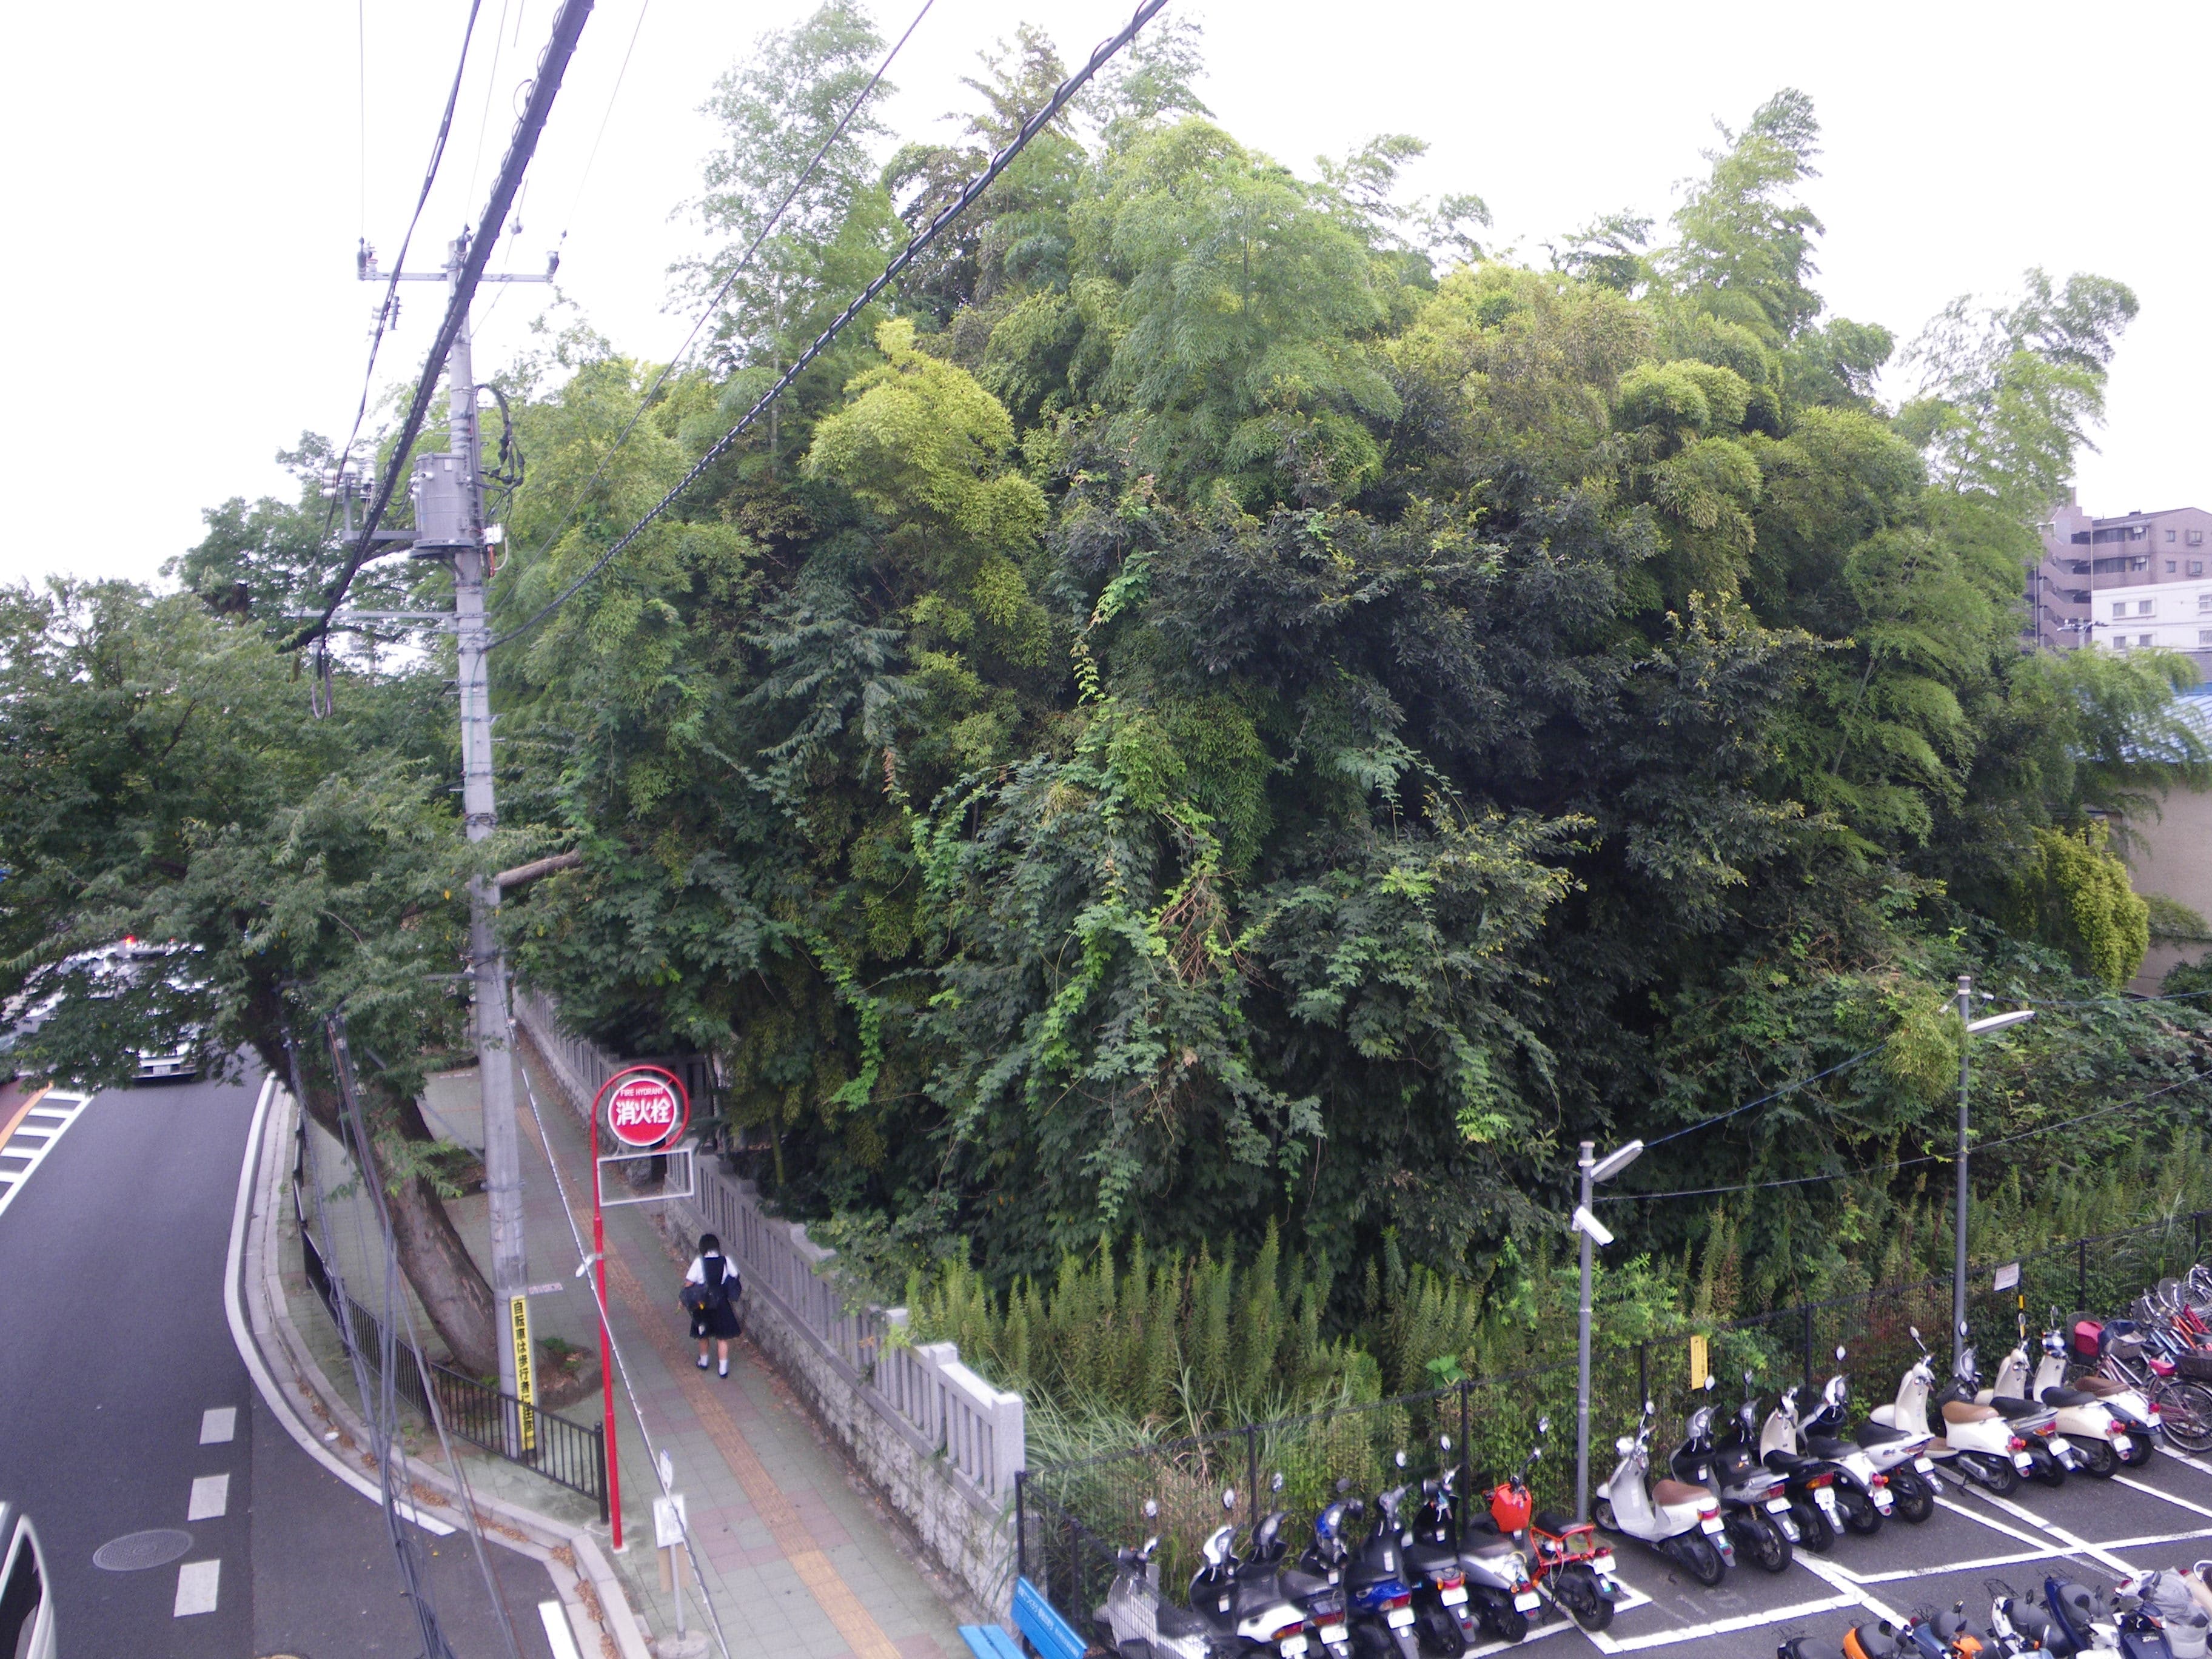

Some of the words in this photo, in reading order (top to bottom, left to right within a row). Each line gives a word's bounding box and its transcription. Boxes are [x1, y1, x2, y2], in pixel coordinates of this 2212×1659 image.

[620, 1088, 635, 1097] FIRE
[635, 1087, 664, 1096] HYDRANT
[616, 1098, 671, 1126] 消火栓
